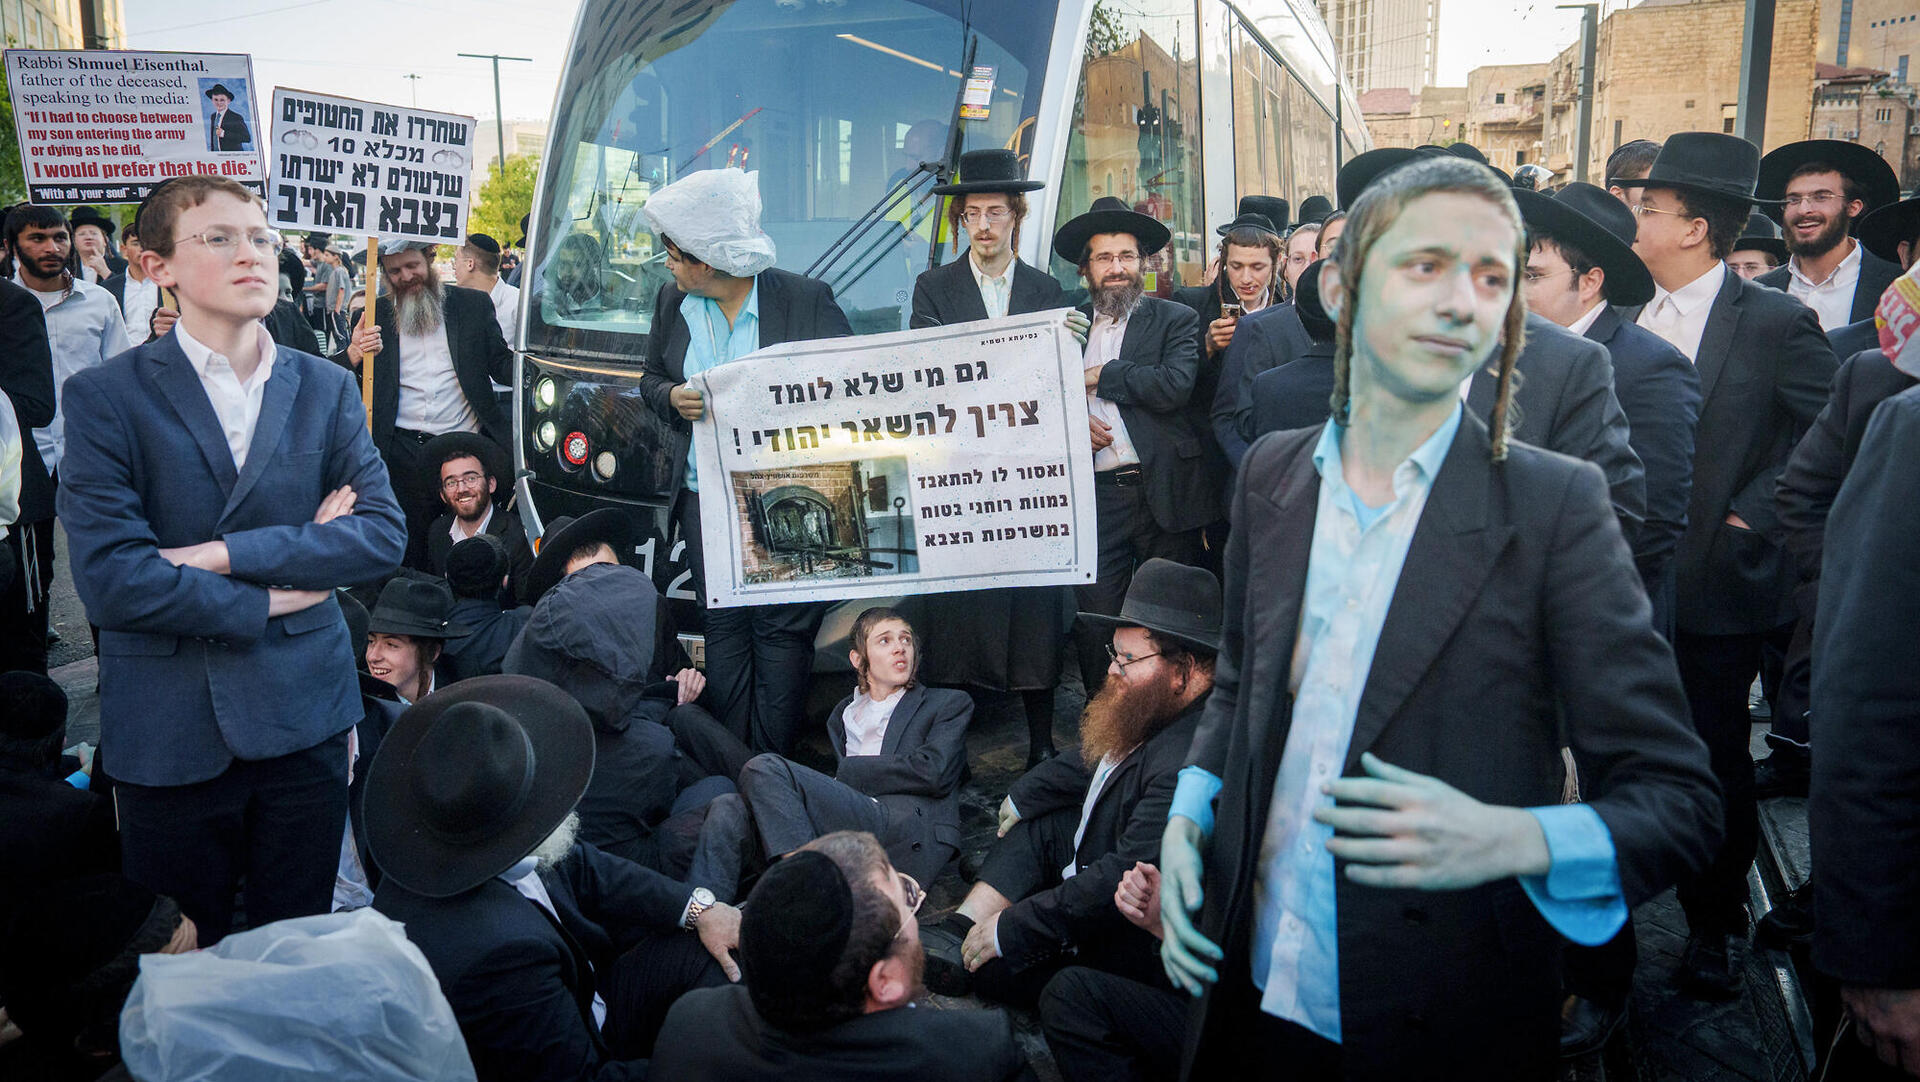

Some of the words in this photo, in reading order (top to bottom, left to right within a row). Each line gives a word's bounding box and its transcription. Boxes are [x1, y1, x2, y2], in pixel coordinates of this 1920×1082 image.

[17, 56, 62, 69] Rabbi
[67, 57, 128, 70] Shmuel
[133, 58, 208, 73] Eisenthal,
[21, 73, 64, 86] father
[69, 74, 86, 86] of
[90, 74, 112, 87] the
[117, 75, 187, 89] deceased,
[22, 91, 91, 107] speaking
[95, 93, 109, 104] to
[114, 92, 136, 104] the
[141, 92, 189, 105] media:
[41, 111, 47, 123] I
[49, 111, 74, 123] had
[75, 112, 89, 123] to
[91, 111, 138, 123] choose
[140, 112, 193, 124] between
[282, 97, 364, 132] החטופים
[371, 109, 399, 137] את
[28, 130, 47, 141] my
[49, 129, 74, 140] son
[76, 128, 130, 141] entering
[131, 128, 152, 140] the
[154, 129, 185, 141] army
[407, 115, 468, 146] שחררו
[31, 146, 44, 156] or
[47, 145, 83, 157] dying
[85, 146, 100, 156] as
[102, 144, 119, 156] he
[121, 144, 144, 157] did,
[327, 137, 355, 155] 10
[363, 139, 424, 163] מכלא
[33, 162, 41, 178] I
[43, 162, 99, 178] would
[102, 161, 156, 179] prefer
[158, 161, 193, 177] that
[196, 160, 218, 175] he
[221, 160, 257, 176] die."
[280, 153, 344, 184] ישרתו
[351, 161, 380, 188] לא
[387, 166, 463, 198] שלעולם
[35, 188, 65, 200] "With
[66, 188, 79, 199] all
[80, 189, 104, 201] your
[106, 187, 130, 199] soul"
[277, 184, 366, 230] האויב
[378, 195, 459, 239] בצבא
[914, 366, 945, 388] מי
[954, 359, 989, 384] גם
[768, 376, 833, 405] לומד
[843, 371, 904, 399] שלא
[840, 403, 957, 444] להשאר
[967, 399, 1040, 438] צריך
[752, 423, 831, 453] יהודי
[917, 469, 983, 490] להתאבד
[991, 466, 1008, 483] לו
[1016, 463, 1065, 480] ואסור
[920, 503, 963, 519] בטוח
[968, 498, 1013, 514] רוחני
[1019, 494, 1069, 511] במוות
[924, 530, 974, 547] הצבא
[981, 523, 1070, 542] במשרפות
